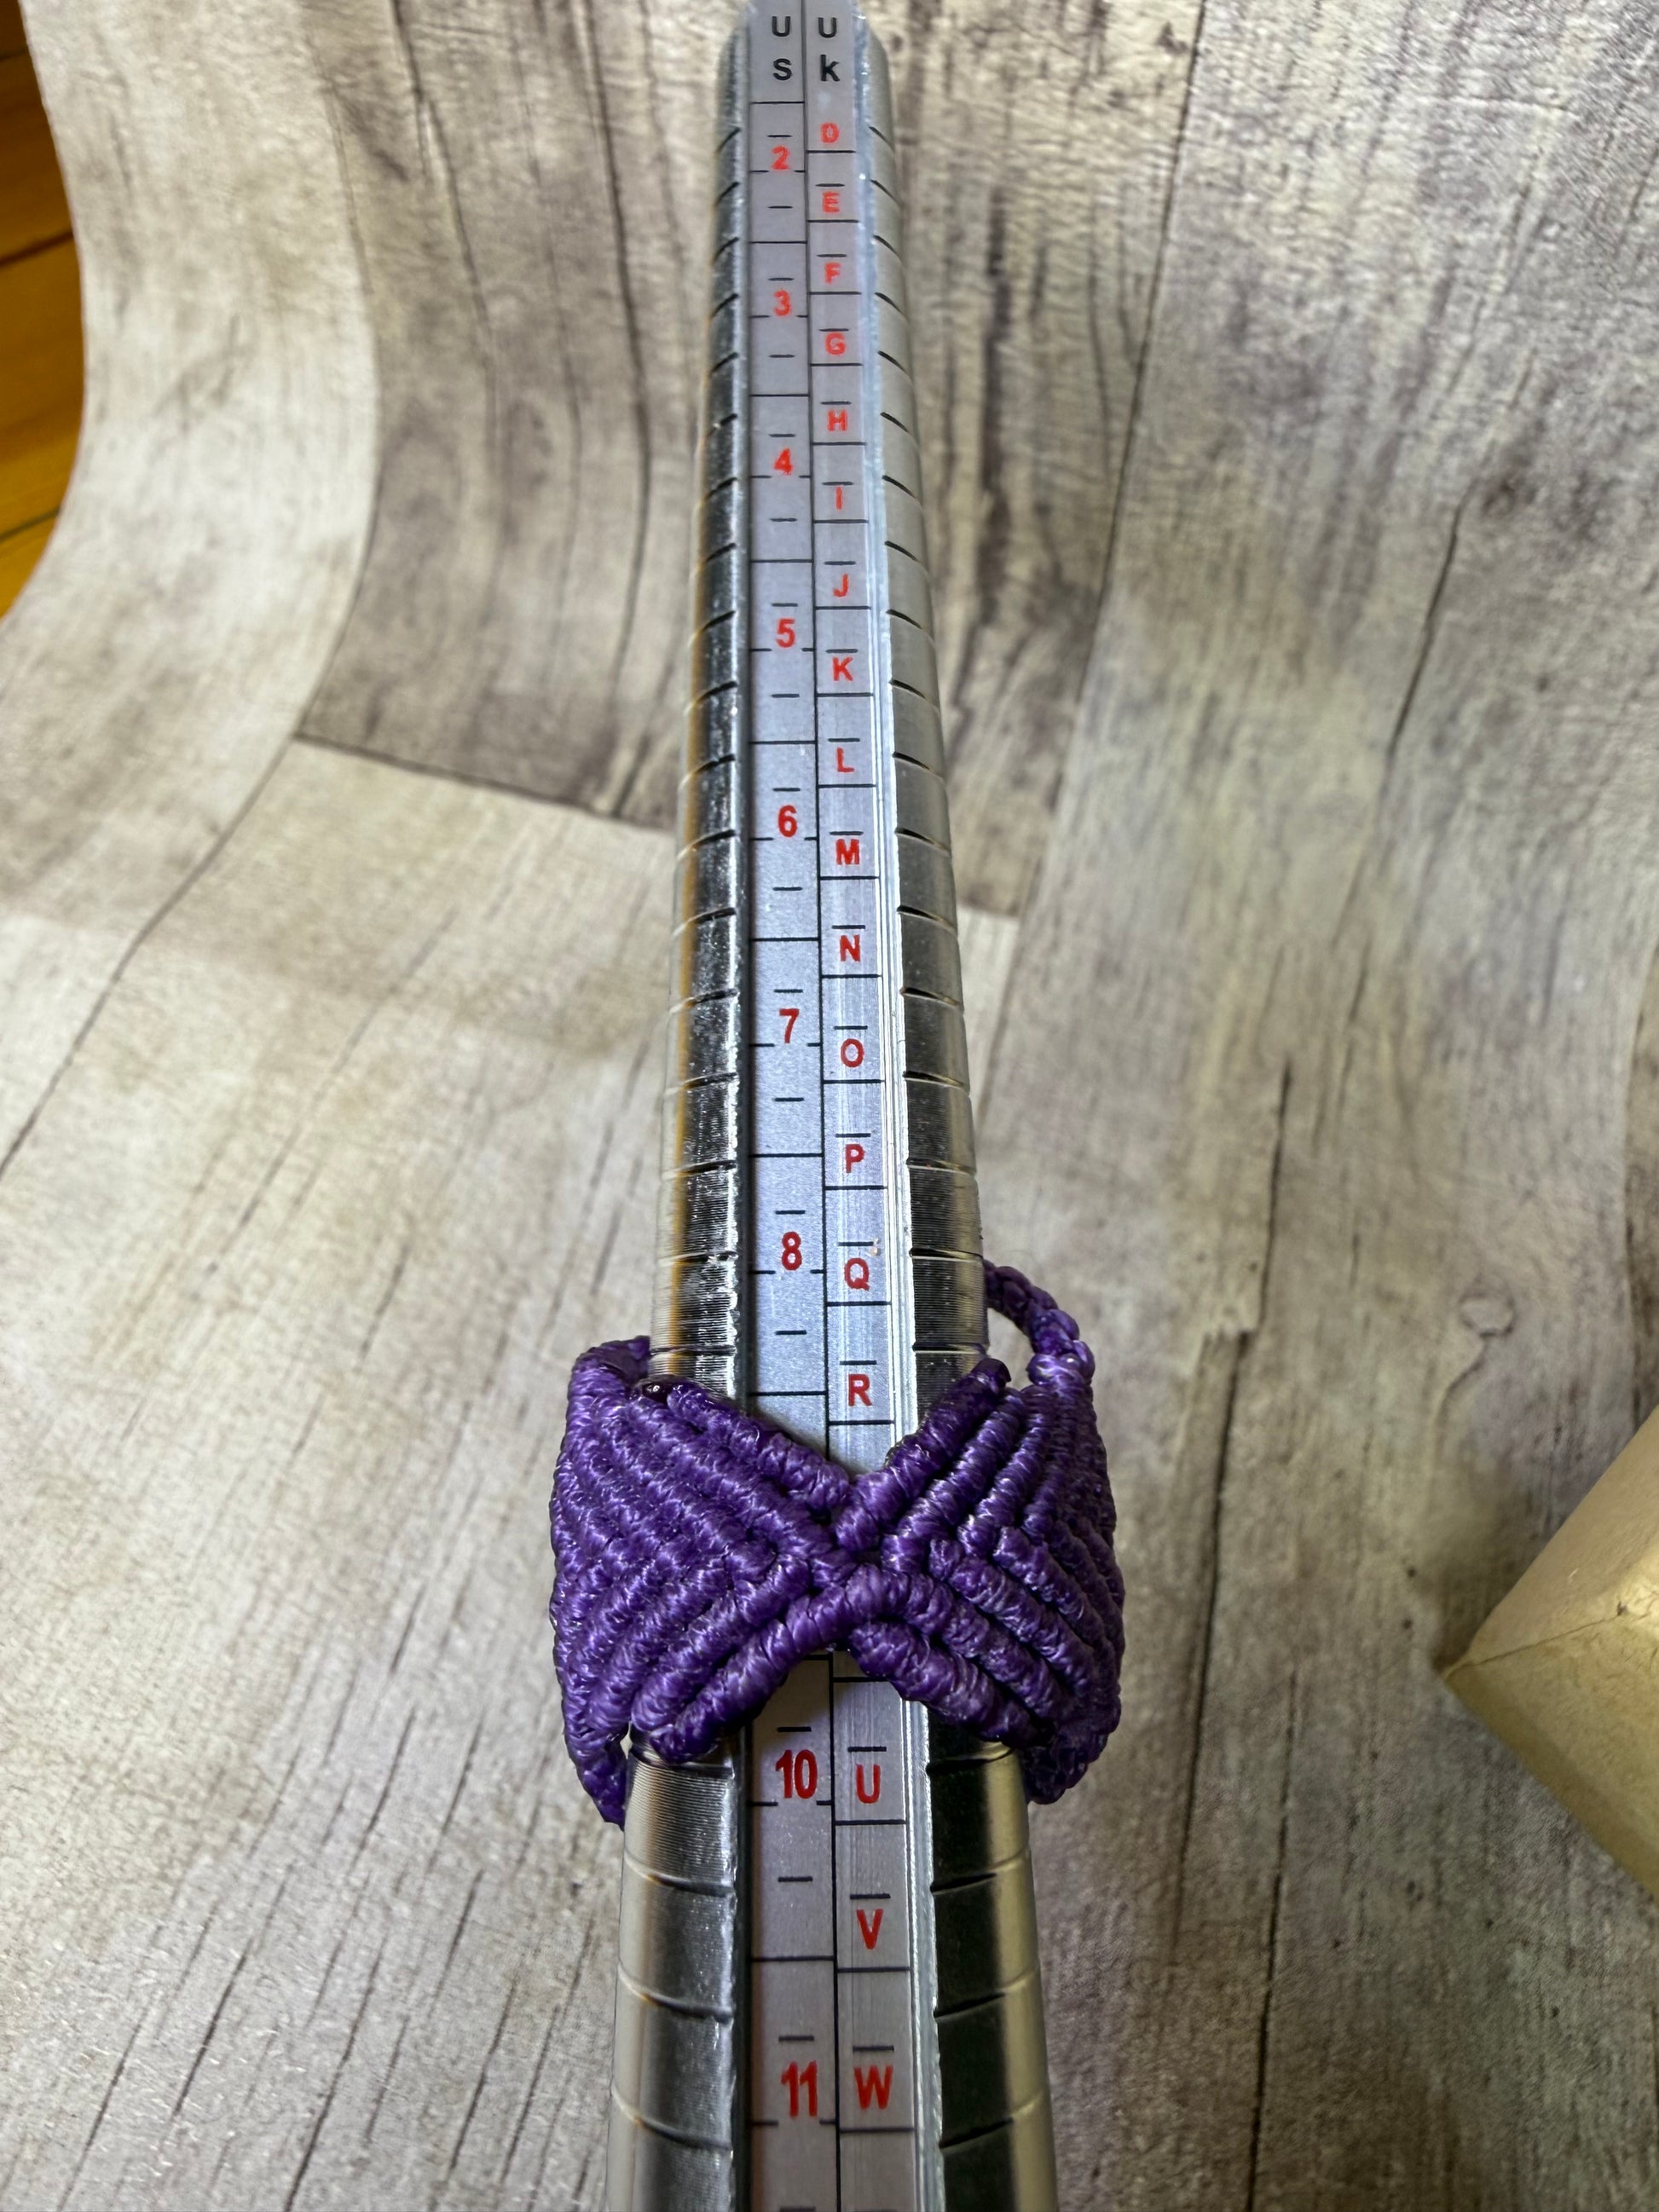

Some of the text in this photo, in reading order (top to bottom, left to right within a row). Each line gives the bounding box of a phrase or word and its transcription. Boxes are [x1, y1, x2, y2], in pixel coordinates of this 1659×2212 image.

[820, 122, 840, 144] D
[772, 146, 790, 170] 2
[822, 191, 841, 214] E
[824, 262, 842, 284] F
[773, 289, 792, 317] 3
[824, 332, 847, 355] G
[826, 409, 848, 432] H
[773, 448, 794, 476] 4
[835, 486, 843, 511] I
[832, 574, 849, 598] J
[776, 618, 796, 649] 5
[832, 656, 854, 682] K
[835, 747, 855, 773] L
[777, 805, 799, 838] 6
[835, 839, 861, 865] M
[839, 934, 862, 962] N
[778, 1008, 801, 1044] 7
[840, 1038, 864, 1068] O
[845, 1143, 865, 1174] P
[781, 1231, 803, 1271] 8
[843, 1257, 870, 1292] Q
[847, 1374, 872, 1406] R
[776, 1750, 818, 1799] 10
[855, 1764, 882, 1805] U
[856, 1909, 884, 1950] V
[780, 2060, 818, 2117] 11
[854, 2065, 894, 2111] W
